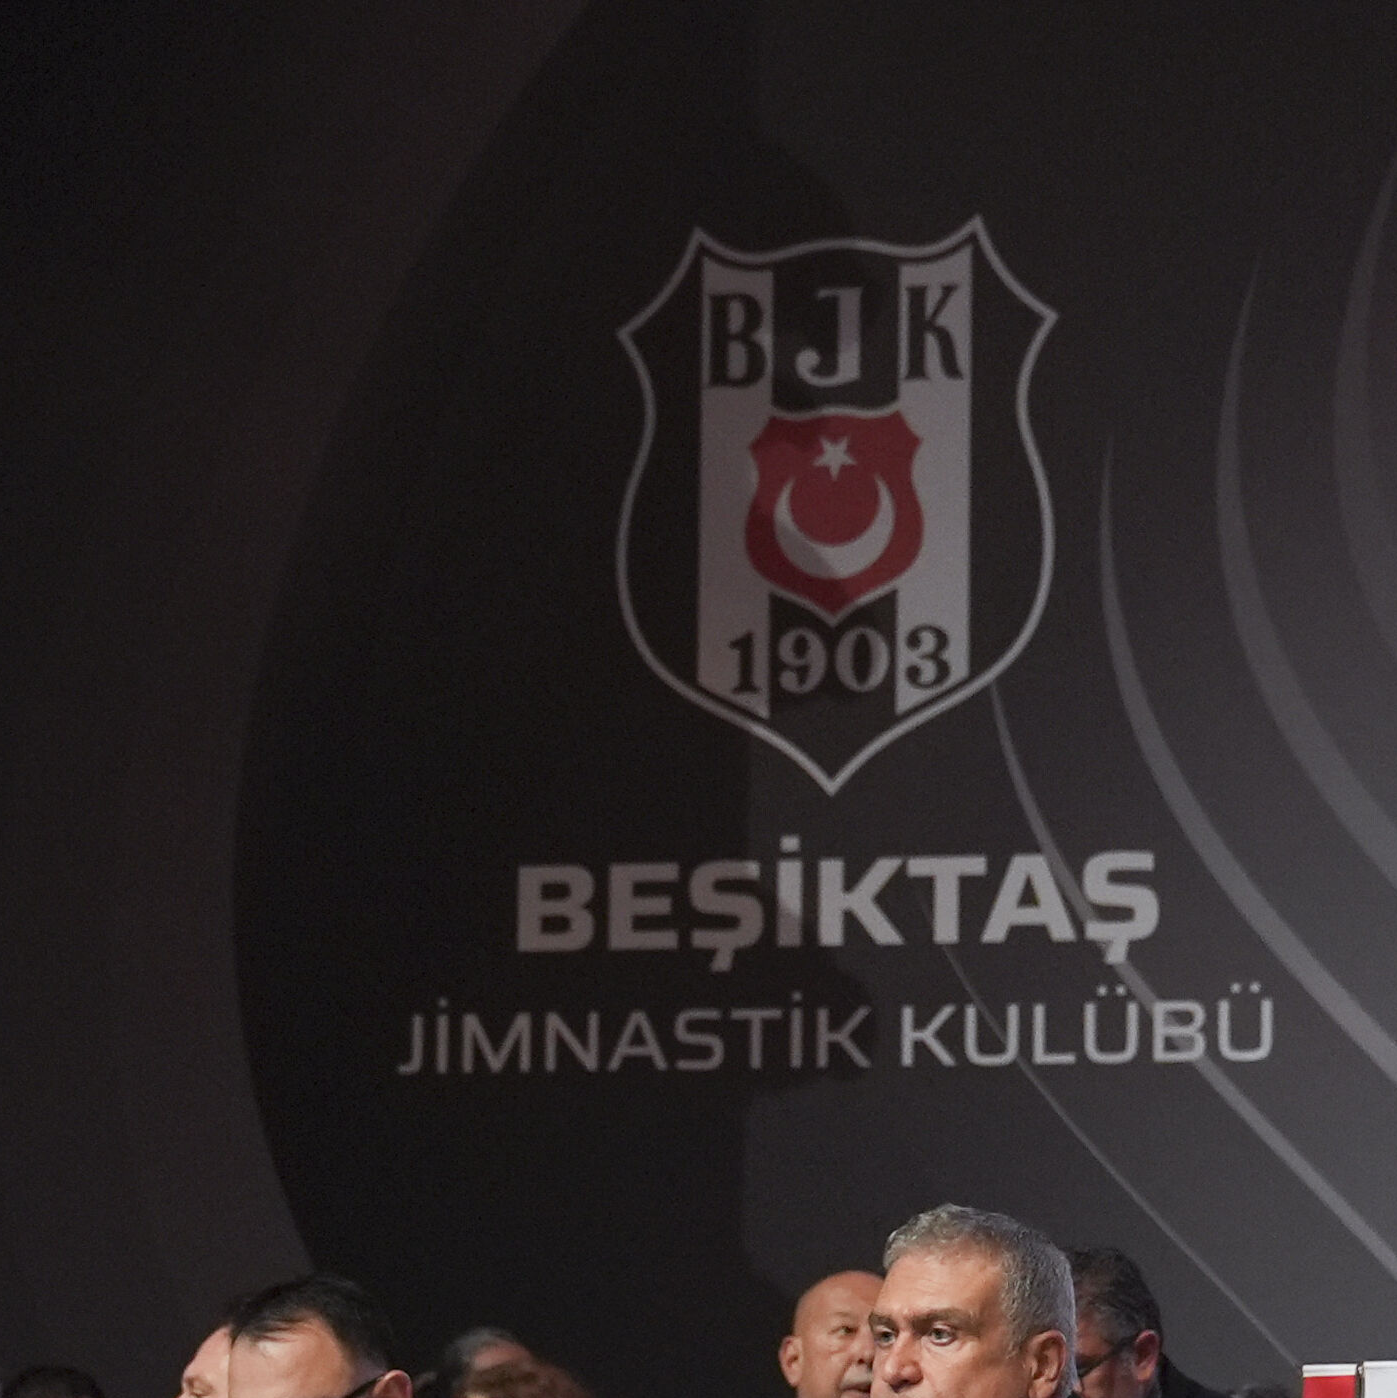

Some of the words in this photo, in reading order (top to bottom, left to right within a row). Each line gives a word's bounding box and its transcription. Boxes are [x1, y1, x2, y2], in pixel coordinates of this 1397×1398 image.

[727, 624, 951, 695] 1903
[516, 834, 1160, 972] BEŞİKTAŞ
[398, 993, 871, 1075] JİMNASTİK
[900, 983, 1274, 1068] KULÜBÜ
